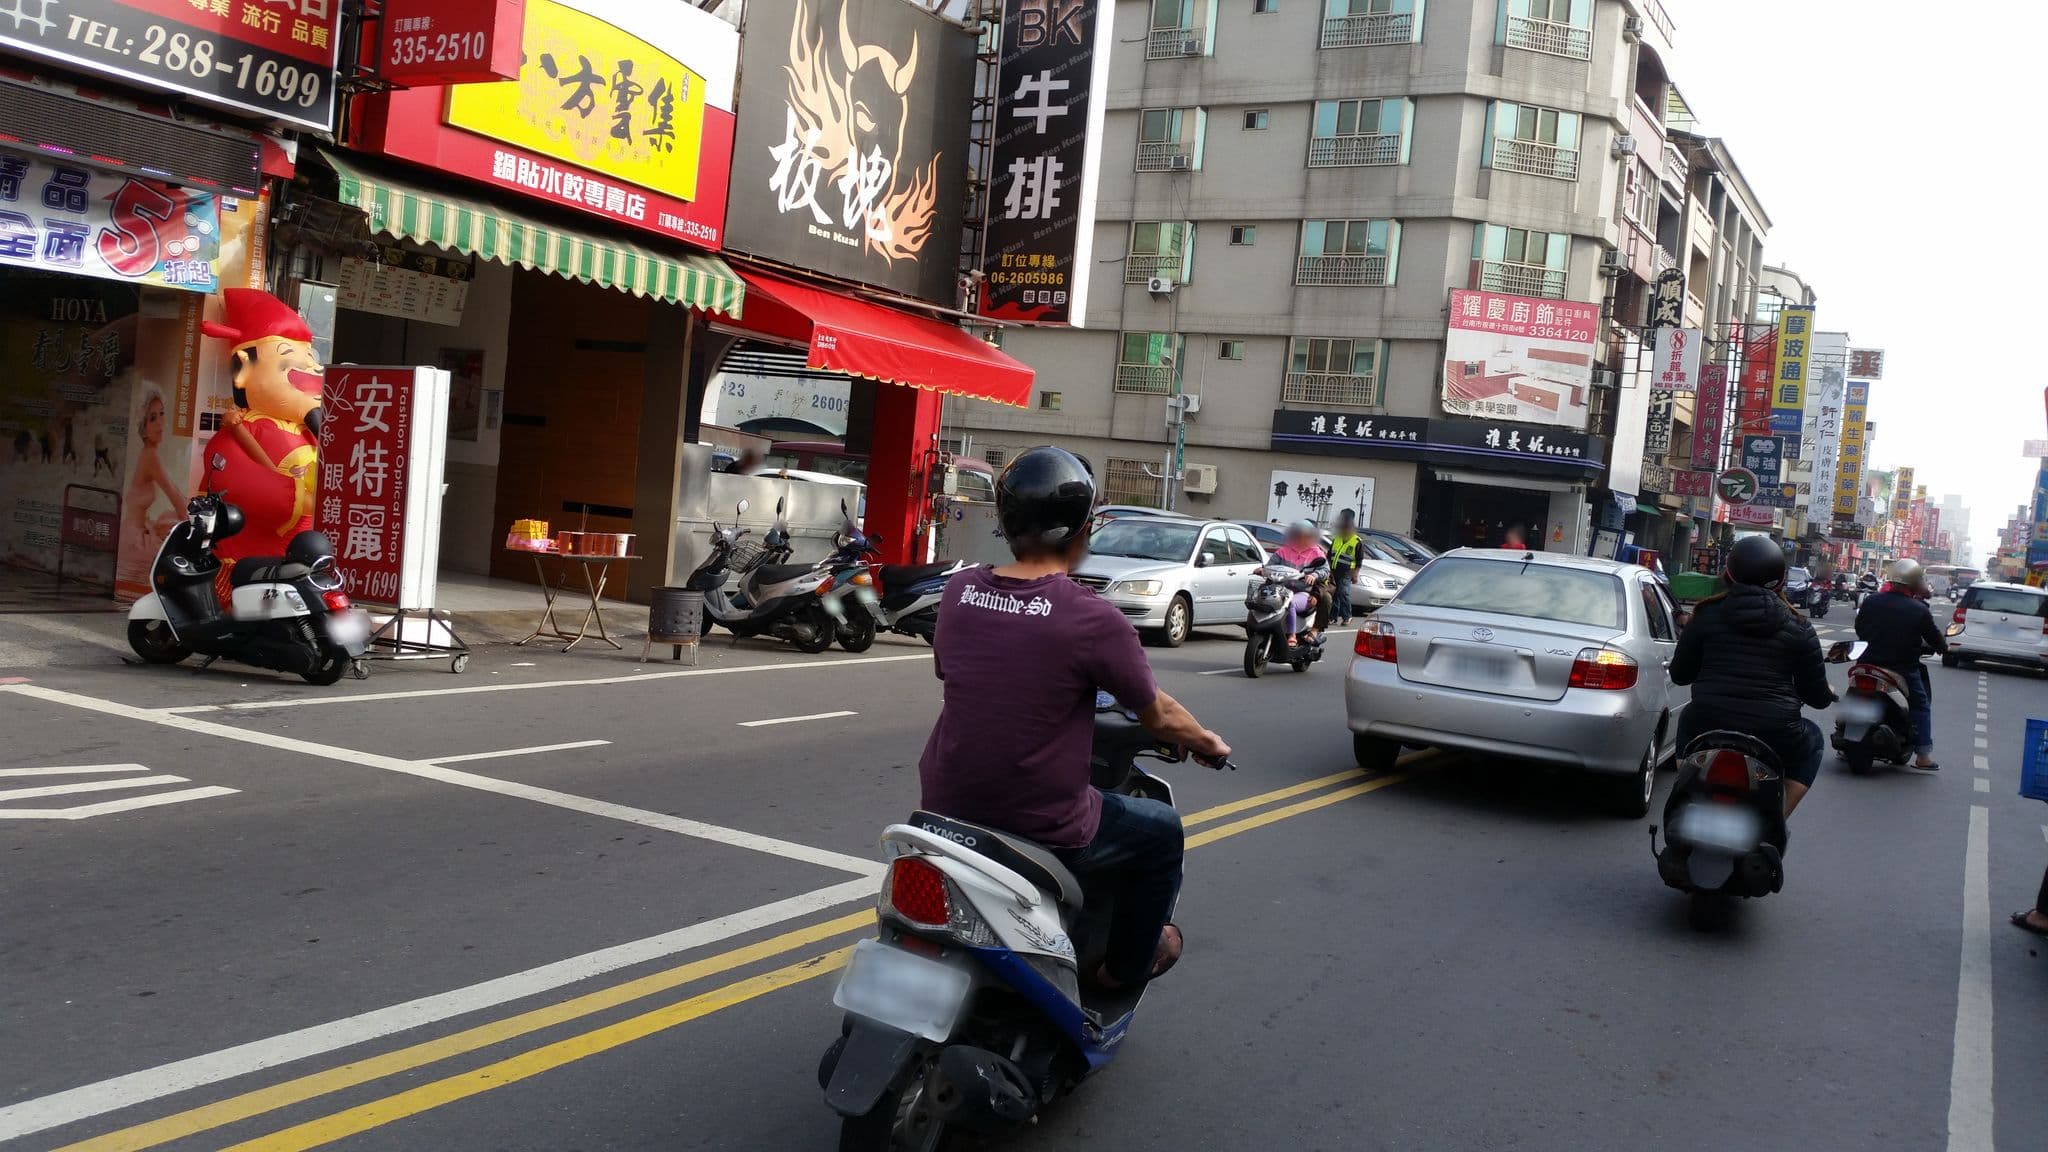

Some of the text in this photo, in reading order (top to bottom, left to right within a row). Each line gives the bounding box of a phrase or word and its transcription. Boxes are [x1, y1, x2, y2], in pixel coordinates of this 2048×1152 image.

[241, 2, 281, 34] 流行
[291, 18, 329, 49] 品質
[1017, 5, 1084, 48] BK
[67, 14, 320, 107] TEL: 288-1699
[391, 31, 485, 65] 335-2510
[1004, 70, 1070, 219] 牛排
[492, 150, 647, 220] 鍋貼水餃專賣店
[97, 177, 177, 278] 5
[164, 259, 212, 286] 折起
[808, 224, 859, 248] Ben Kuai
[1001, 254, 1056, 268] 訂位專線
[991, 272, 1064, 285] 06-2605986
[51, 297, 107, 322] HOYA
[1462, 294, 1555, 327] 耀慶廚飾
[1528, 325, 1588, 341] 3364120
[1779, 315, 1807, 404] 摩波通信
[343, 375, 394, 562] 安特麗
[389, 386, 409, 563] Fashion Optical Shop
[333, 566, 398, 598] 88-1699
[958, 585, 1053, 617] Beatitude-Sd
[922, 822, 977, 847] KYMCO
